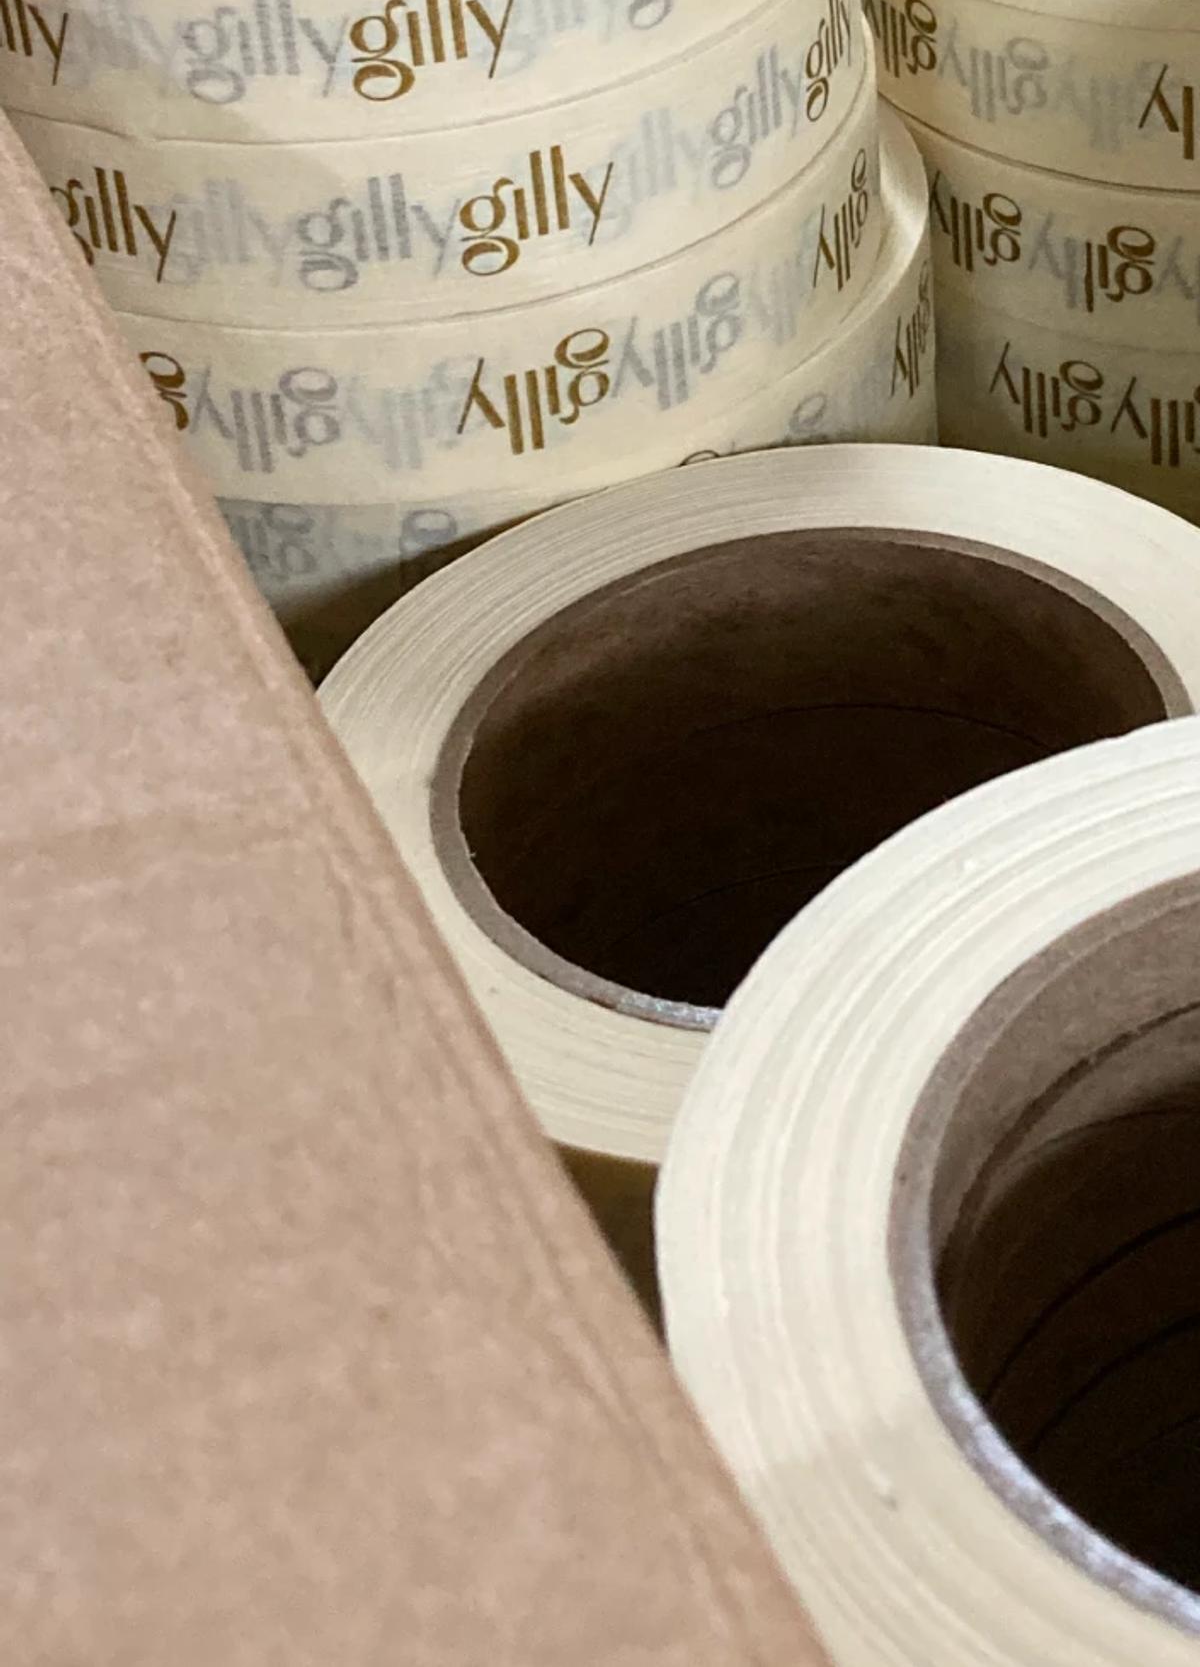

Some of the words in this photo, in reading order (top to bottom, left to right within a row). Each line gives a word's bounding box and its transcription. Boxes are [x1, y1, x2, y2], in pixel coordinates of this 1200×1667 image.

[459, 144, 614, 276] gilly
[813, 147, 870, 292] gilly
[929, 170, 1022, 272] gilly
[457, 328, 610, 455] gilly
[990, 341, 1104, 439] gilly
